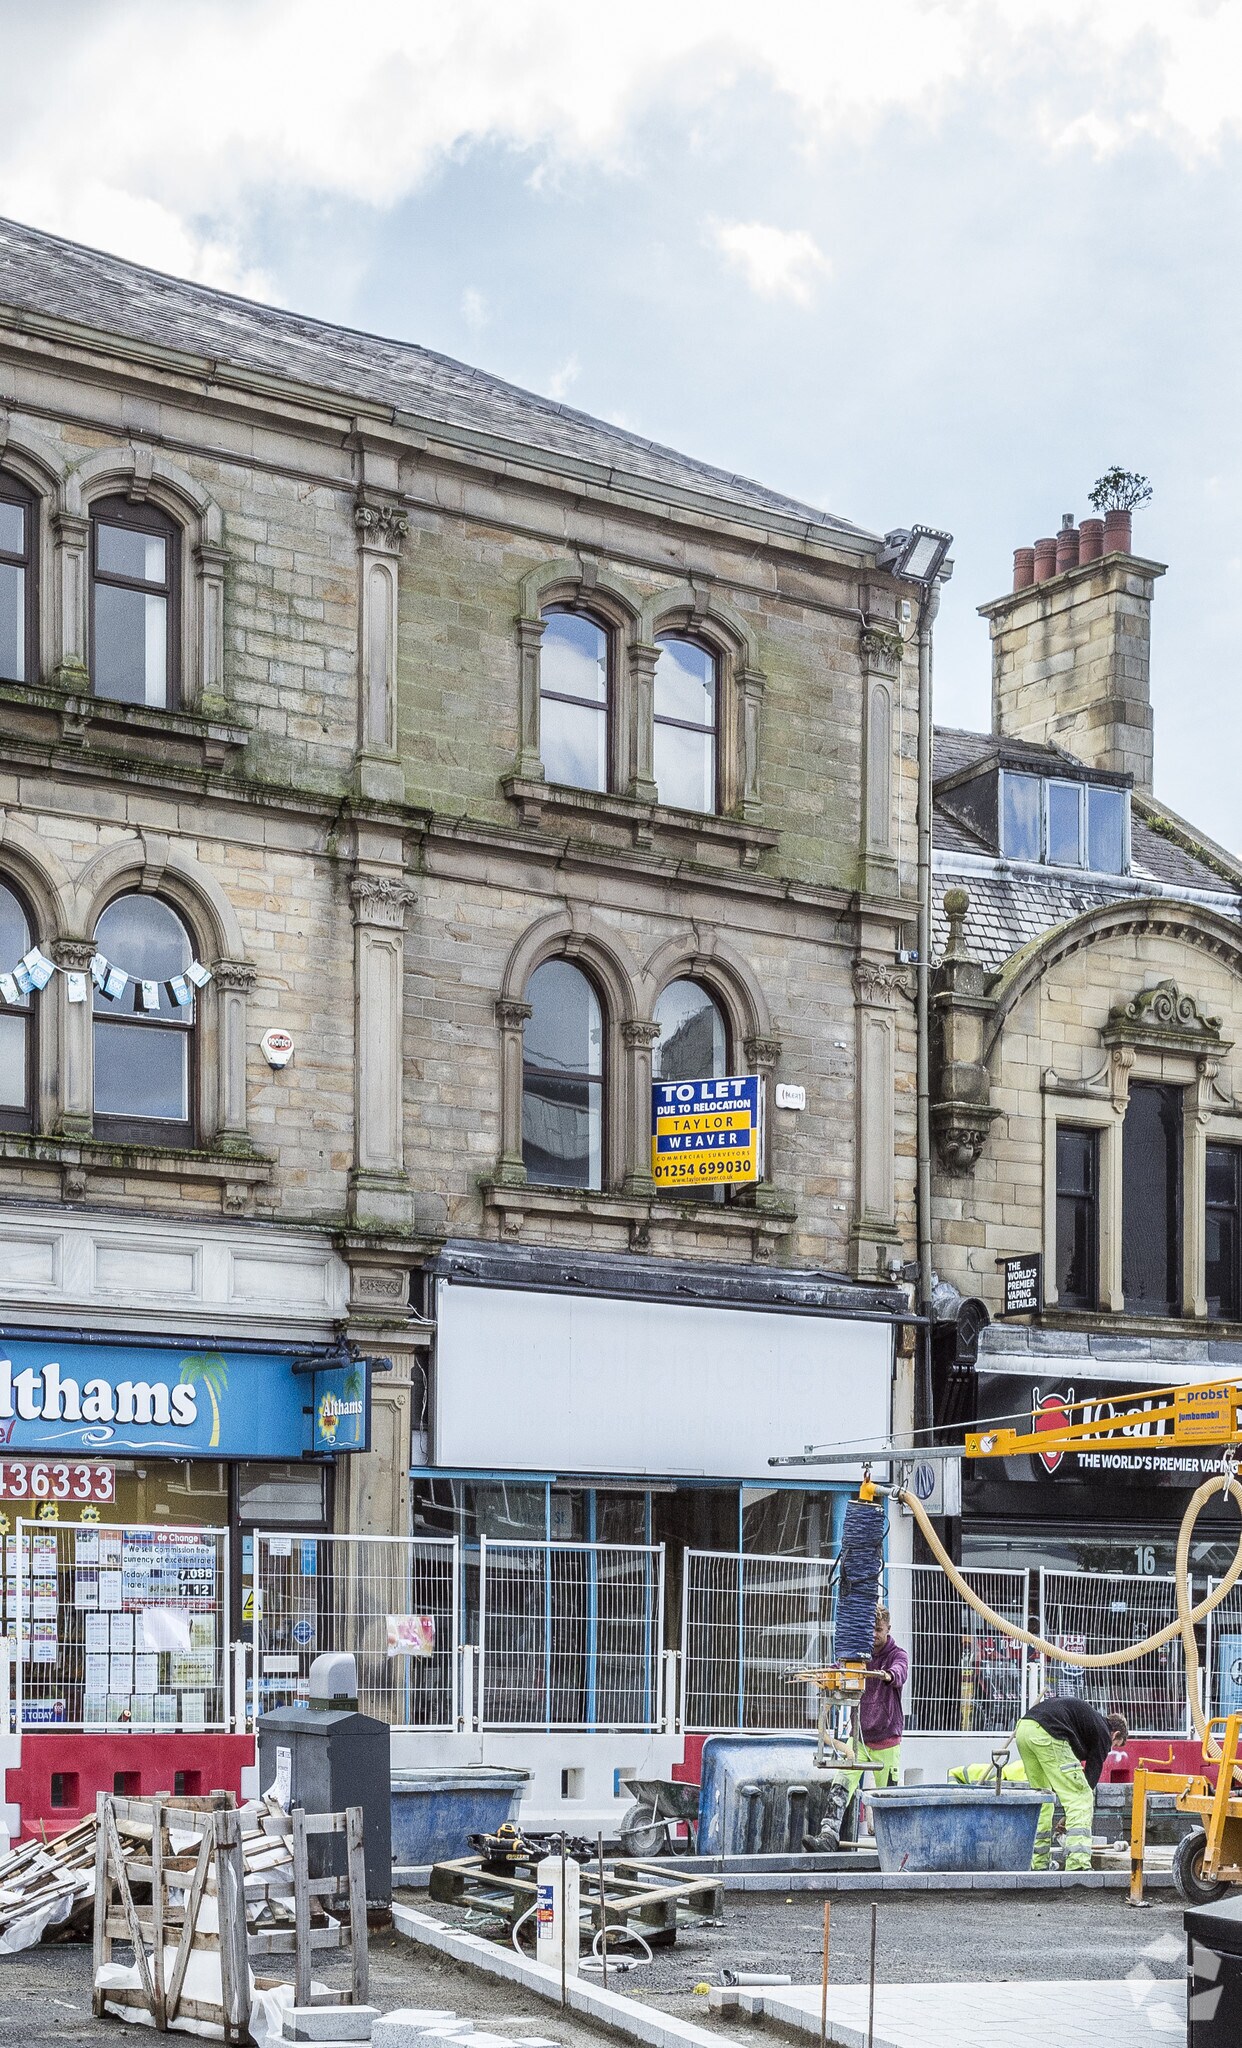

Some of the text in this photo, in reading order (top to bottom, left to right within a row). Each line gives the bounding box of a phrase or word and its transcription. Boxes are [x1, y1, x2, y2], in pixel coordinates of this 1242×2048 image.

[268, 1038, 291, 1047] PROTECT
[661, 1080, 746, 1102] TO LET
[657, 1099, 751, 1115] DUE TO RELOCATION
[673, 1117, 733, 1130] TAYLOR
[669, 1133, 737, 1148] WEAVER
[655, 1160, 751, 1177] 01254 699030
[672, 1174, 733, 1183] www.taylorweaver.co.uk
[1008, 1261, 1021, 1271] THE
[1008, 1269, 1037, 1281] WORLD'S
[1008, 1279, 1035, 1290] PREMIER
[1008, 1289, 1031, 1300] VAPING
[1008, 1298, 1037, 1310] RETAILER
[1187, 1388, 1229, 1403] probst
[323, 1399, 363, 1417] Althams
[1178, 1411, 1219, 1423] jumbomobil
[1077, 1453, 1101, 1468] THE
[1102, 1454, 1152, 1470] WORLD'S
[1153, 1456, 1199, 1472] PREMIER
[157, 1533, 167, 1542] de
[169, 1533, 199, 1544] Change
[129, 1545, 209, 1554] We sell commission free
[123, 1557, 154, 1565] currency
[1134, 1546, 1156, 1575] 16
[180, 1585, 209, 1595] 1.12
[28, 1711, 54, 1720] TODAY
